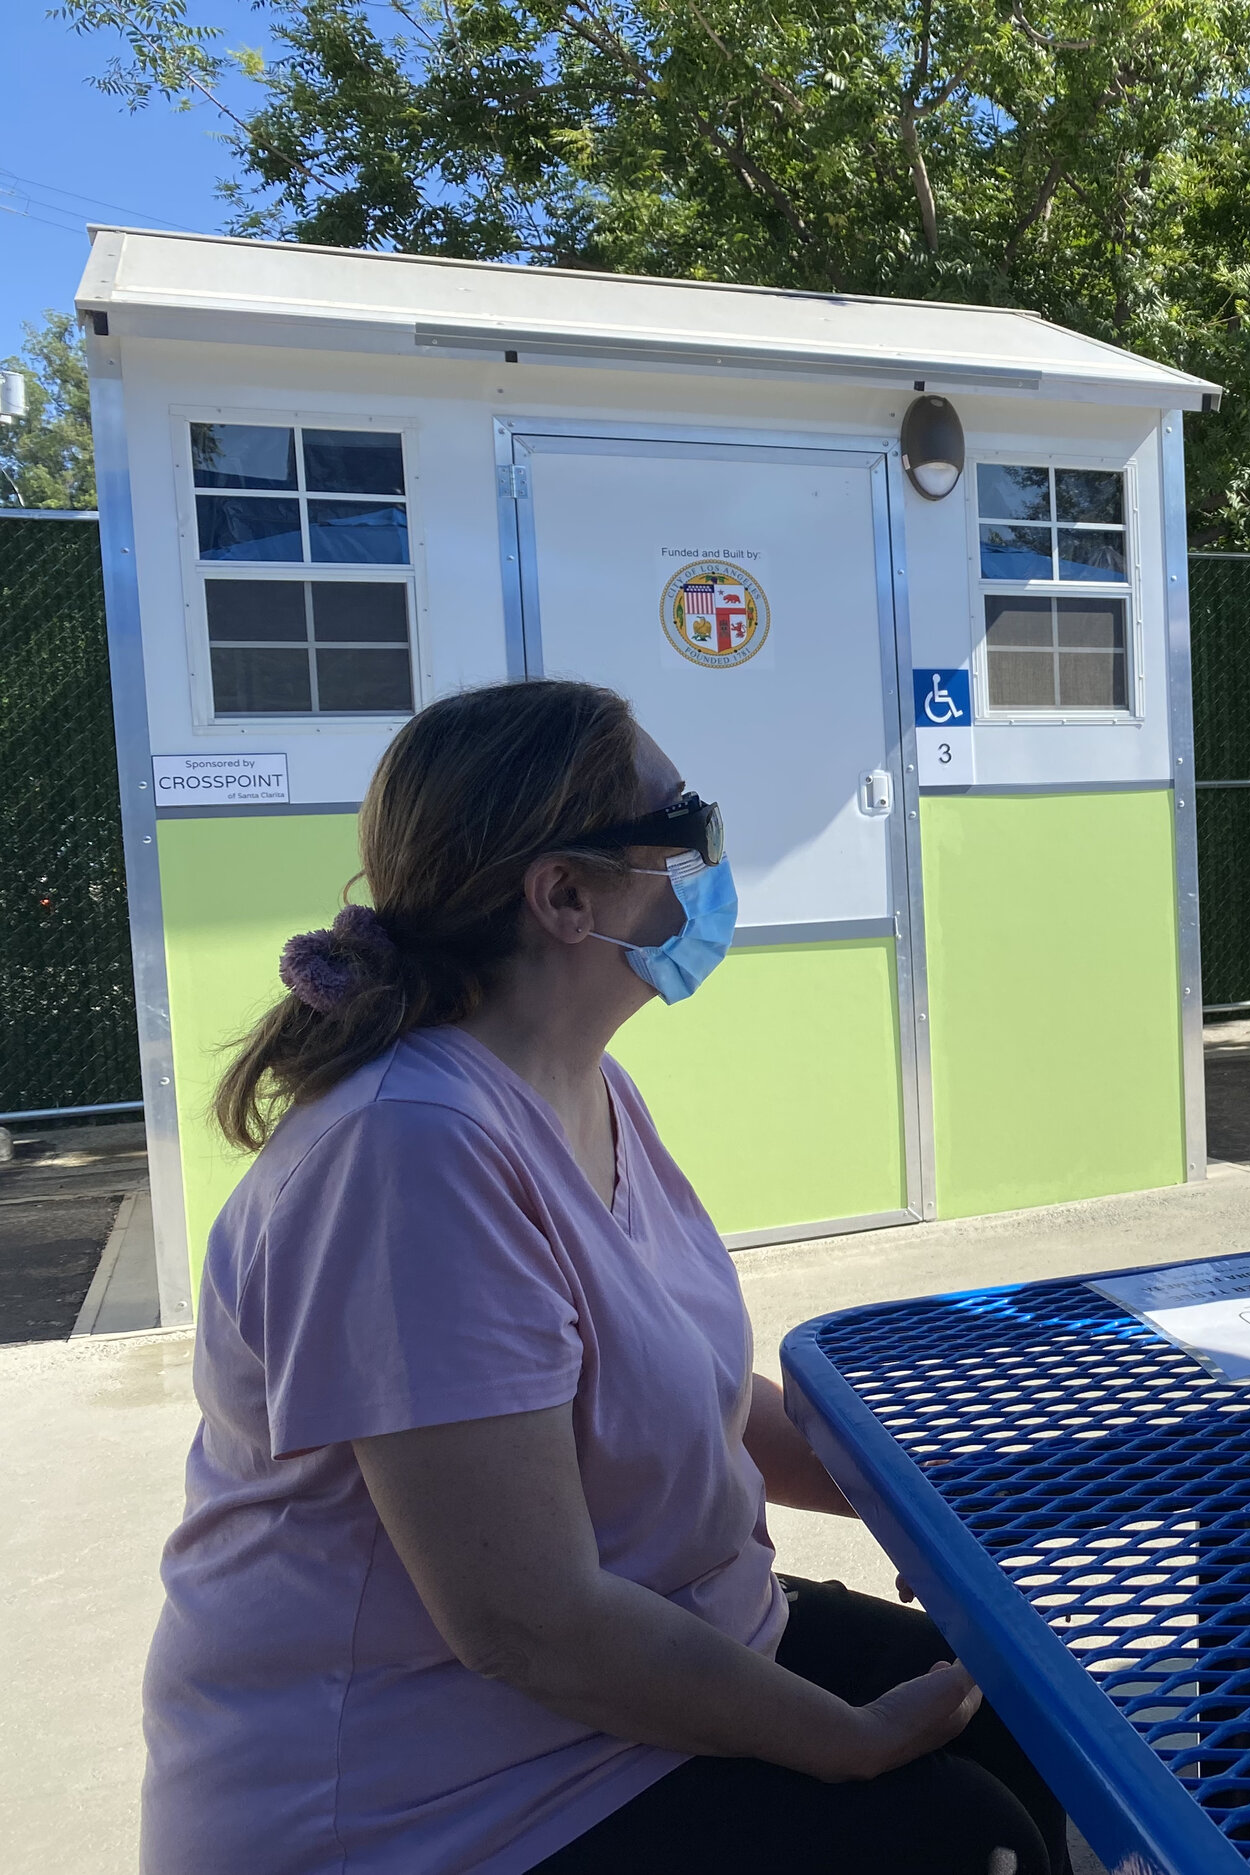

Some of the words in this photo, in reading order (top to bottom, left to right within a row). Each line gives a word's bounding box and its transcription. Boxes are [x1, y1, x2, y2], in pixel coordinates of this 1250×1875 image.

[661, 547, 699, 558] Funded
[701, 548, 720, 558] and
[723, 549, 744, 559] Built
[746, 550, 761, 560] by:
[667, 577, 685, 599] CITY
[684, 567, 699, 578] OF
[700, 564, 720, 573] LOS
[722, 567, 761, 601] ANGELES
[684, 646, 730, 665] FOUNDED
[733, 647, 751, 662] 1781
[938, 743, 952, 764] 3
[185, 759, 240, 770] Sponsored
[242, 759, 256, 769] by
[158, 773, 283, 790] CROSSPOINT
[260, 791, 285, 799] Clarita
[1168, 1289, 1230, 1302] TABLE
